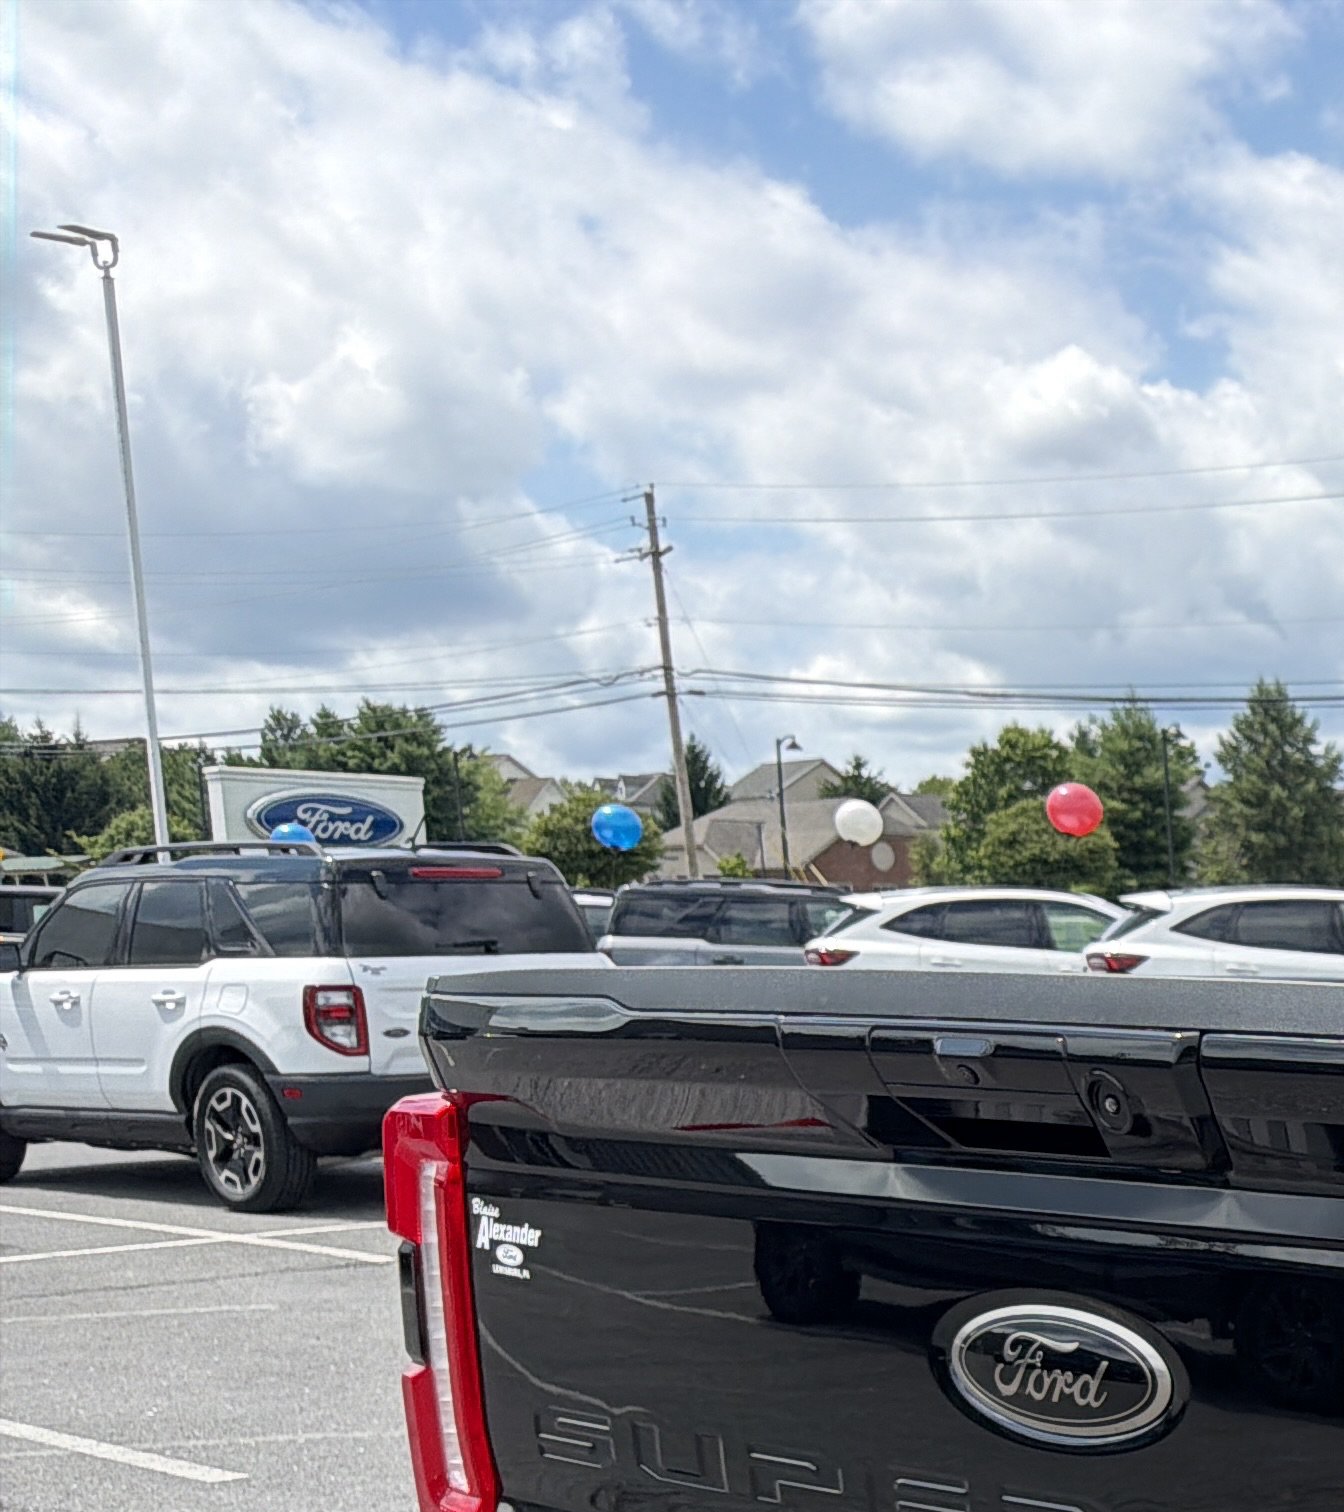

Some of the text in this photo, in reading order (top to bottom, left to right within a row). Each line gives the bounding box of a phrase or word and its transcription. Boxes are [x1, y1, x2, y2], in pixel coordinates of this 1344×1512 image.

[295, 802, 373, 841] Ford
[476, 1215, 542, 1250] Alexander
[994, 1331, 1109, 1408] Ford
